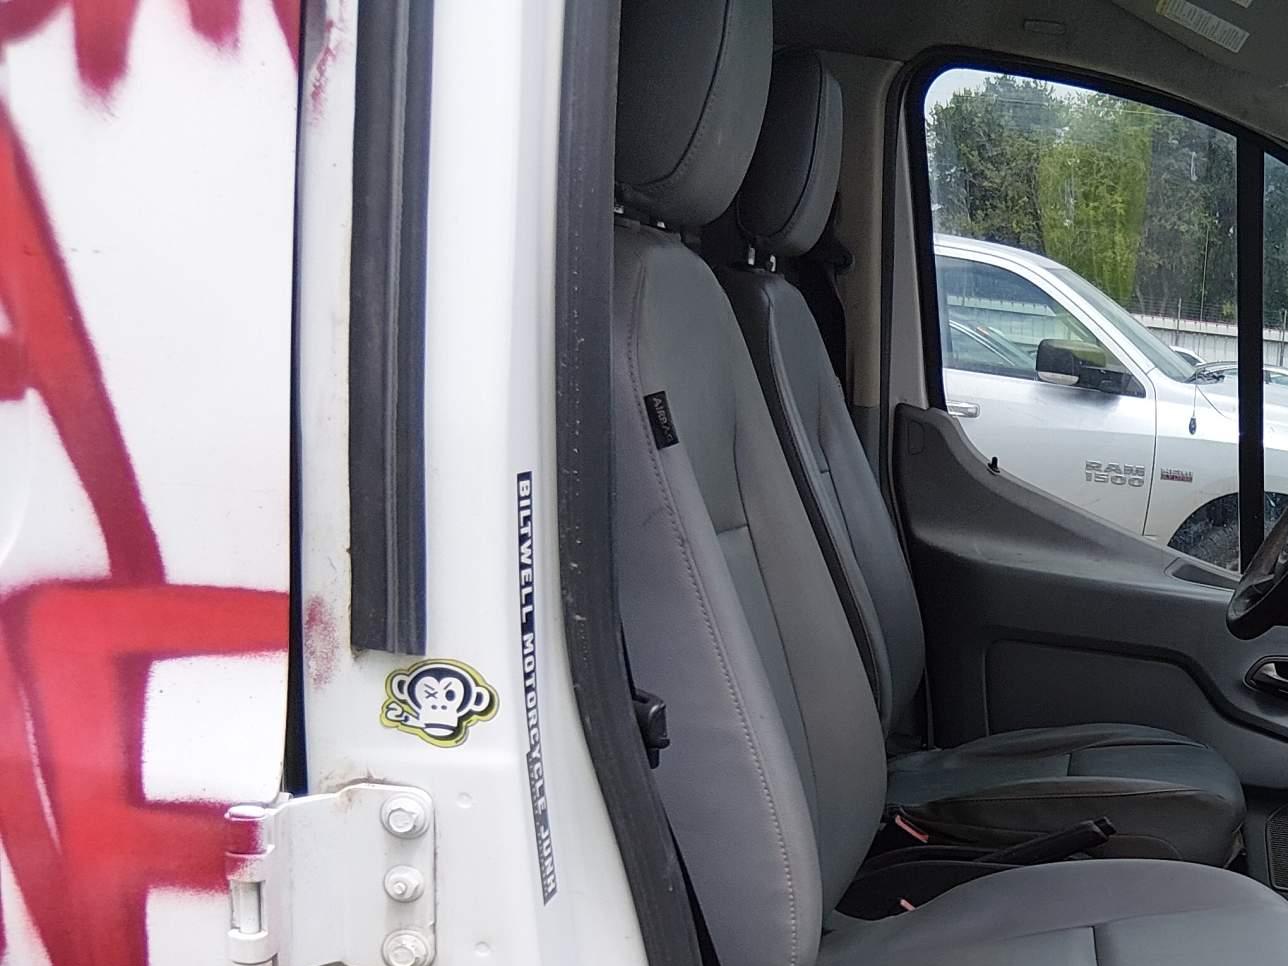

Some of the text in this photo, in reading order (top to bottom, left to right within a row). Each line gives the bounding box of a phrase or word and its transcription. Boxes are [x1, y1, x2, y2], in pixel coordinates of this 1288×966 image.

[1085, 460, 1145, 476] RAM
[1085, 471, 1145, 487] 1500
[519, 478, 535, 624] BILTWELL
[521, 633, 547, 811] MOTORCYCLE
